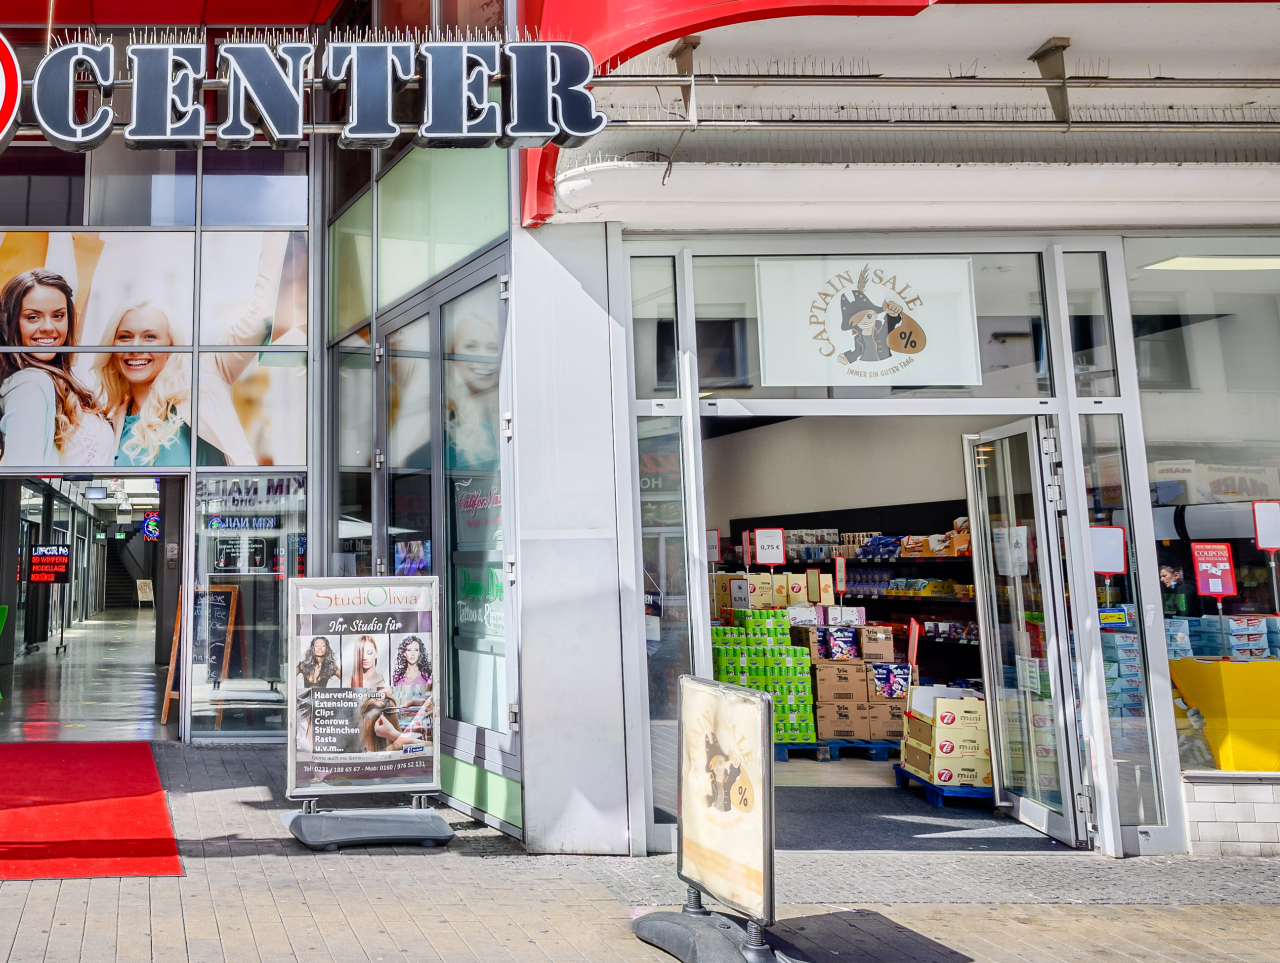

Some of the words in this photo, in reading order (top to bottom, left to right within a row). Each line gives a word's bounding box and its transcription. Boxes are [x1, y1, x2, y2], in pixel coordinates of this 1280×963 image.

[32, 40, 608, 148] CENTER
[809, 270, 855, 358] CAPTAIN
[871, 269, 924, 311] SALE
[846, 367, 868, 378] IMMER
[880, 366, 901, 377] GUTER
[899, 356, 915, 369] FANG
[32, 564, 66, 572] MODELLAGE
[328, 619, 347, 633] Ihr
[349, 617, 383, 632] Studio
[384, 616, 402, 633] für
[314, 691, 386, 699] Haarverlängerung
[315, 700, 358, 708] Extensions
[315, 709, 334, 717] Clips
[315, 726, 360, 734] Strähnchen
[315, 735, 337, 743] Rasta
[959, 743, 980, 751] mini
